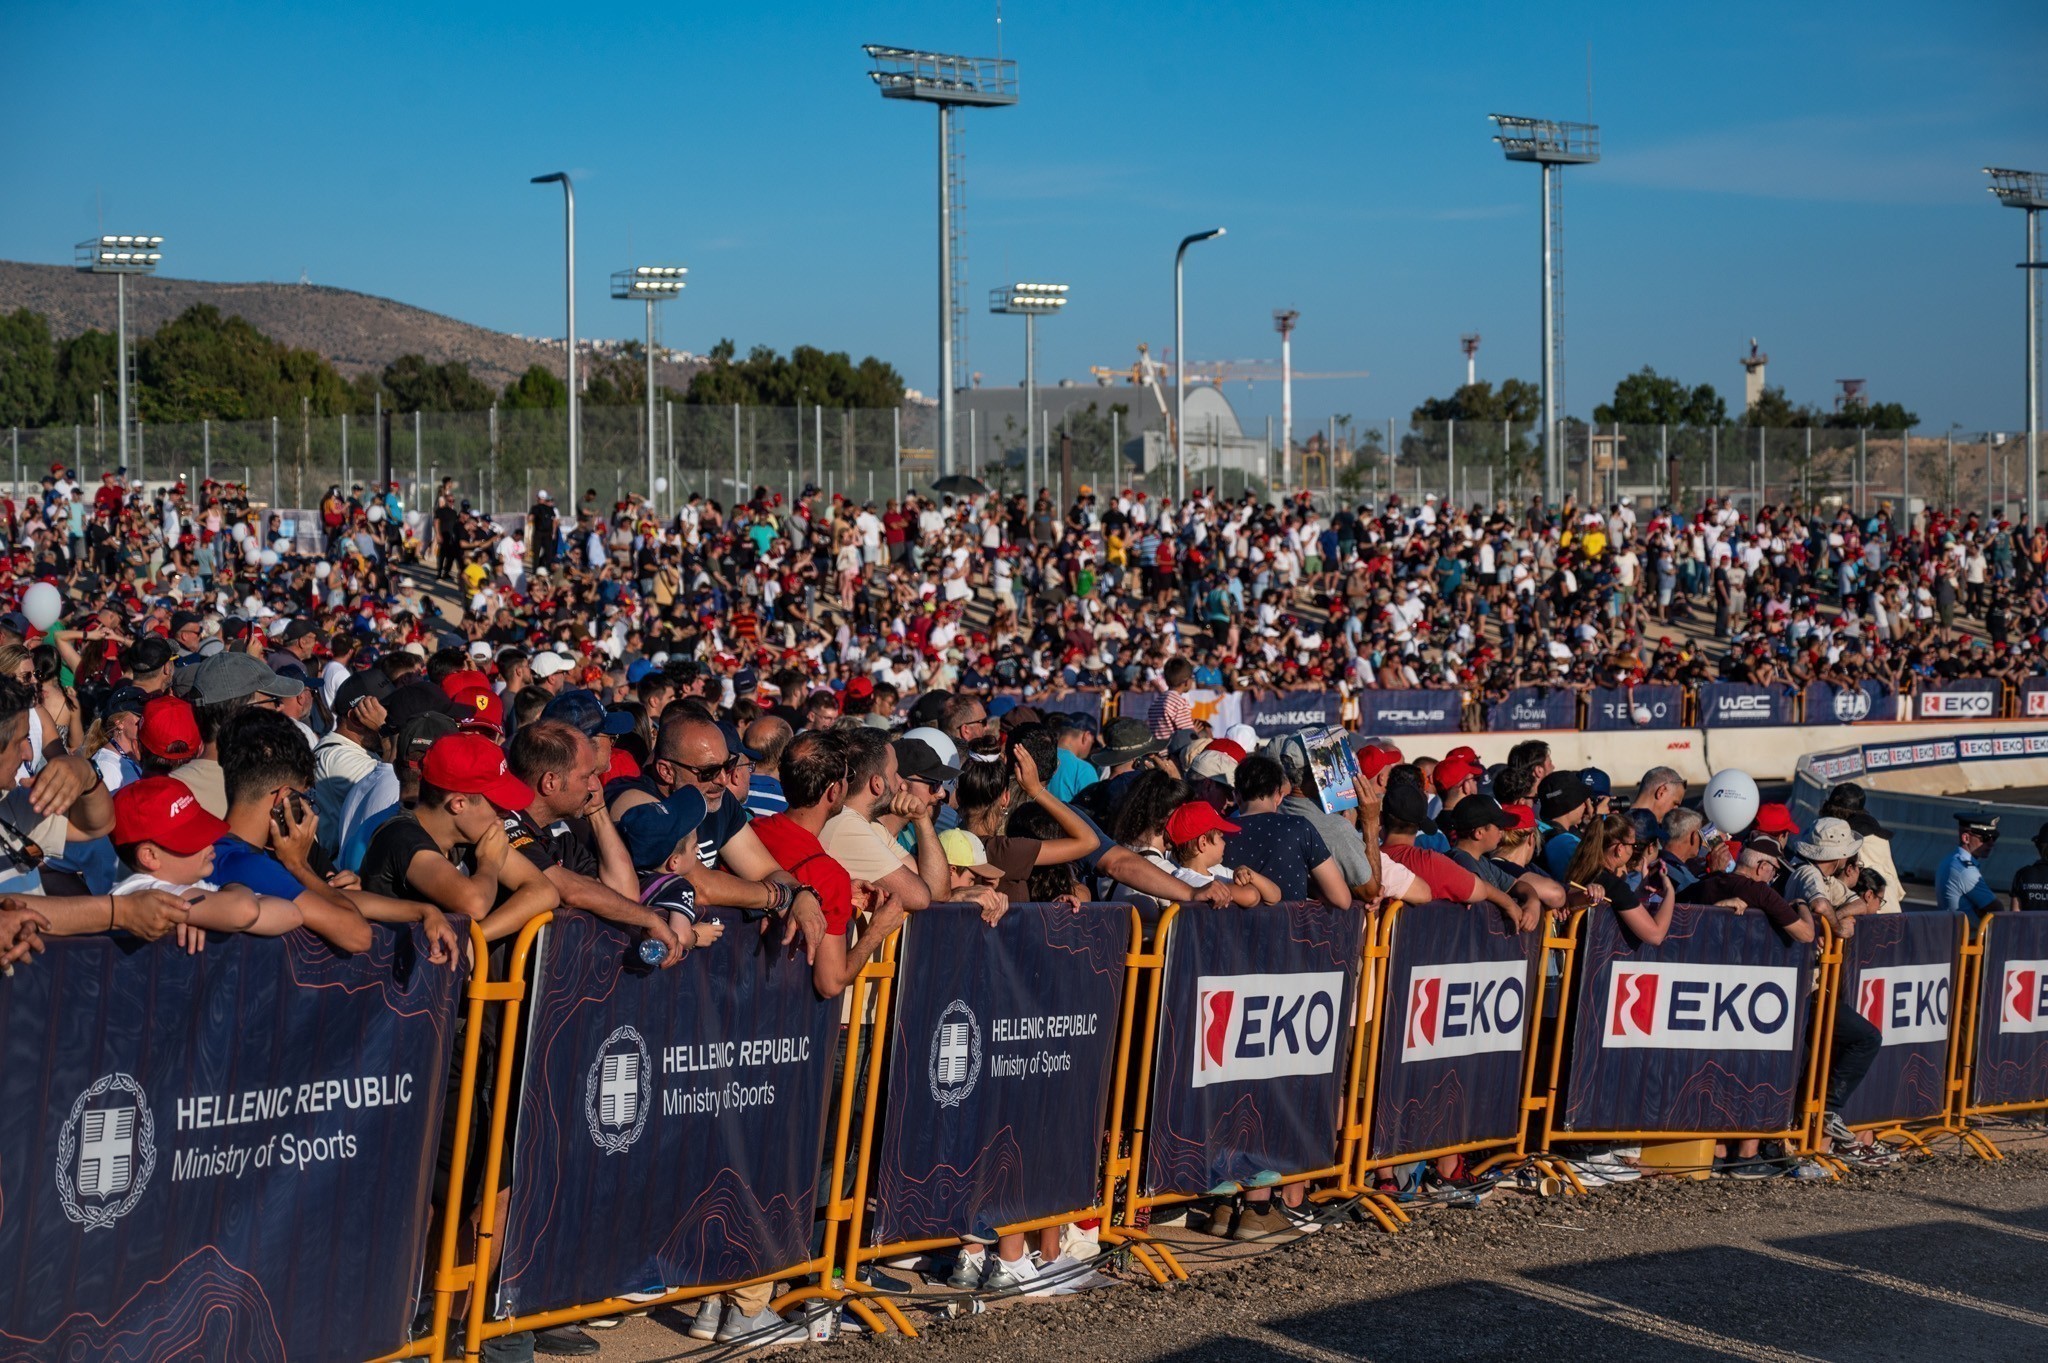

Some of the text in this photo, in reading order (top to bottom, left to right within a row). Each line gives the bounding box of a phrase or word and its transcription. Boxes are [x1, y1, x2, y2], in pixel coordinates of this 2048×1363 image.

[1719, 695, 1771, 710] WRC
[1836, 694, 1868, 713] FIA
[1945, 697, 1990, 711] EKO
[1255, 710, 1326, 726] AsahiKASEI
[1896, 749, 1912, 761] EKO
[1919, 746, 1934, 759] EKO
[1941, 744, 1955, 756] EKO
[1971, 742, 1992, 754] EKO
[2002, 740, 2023, 751] EKO
[1442, 976, 1524, 1038] EKO
[1667, 981, 1789, 1035] EKO
[1891, 977, 1949, 1029] EKO
[992, 1013, 1098, 1042] HELLENIC REPUBLIC
[1234, 990, 1334, 1059] EKO
[663, 1036, 810, 1073] HELLENIC REPUBLIC
[991, 1050, 1071, 1080] Ministry of Sports
[177, 1073, 413, 1130] HELLENIC REPUBLIC
[663, 1080, 775, 1117] Ministry of Sports
[171, 1129, 358, 1182] Ministry of Sports
